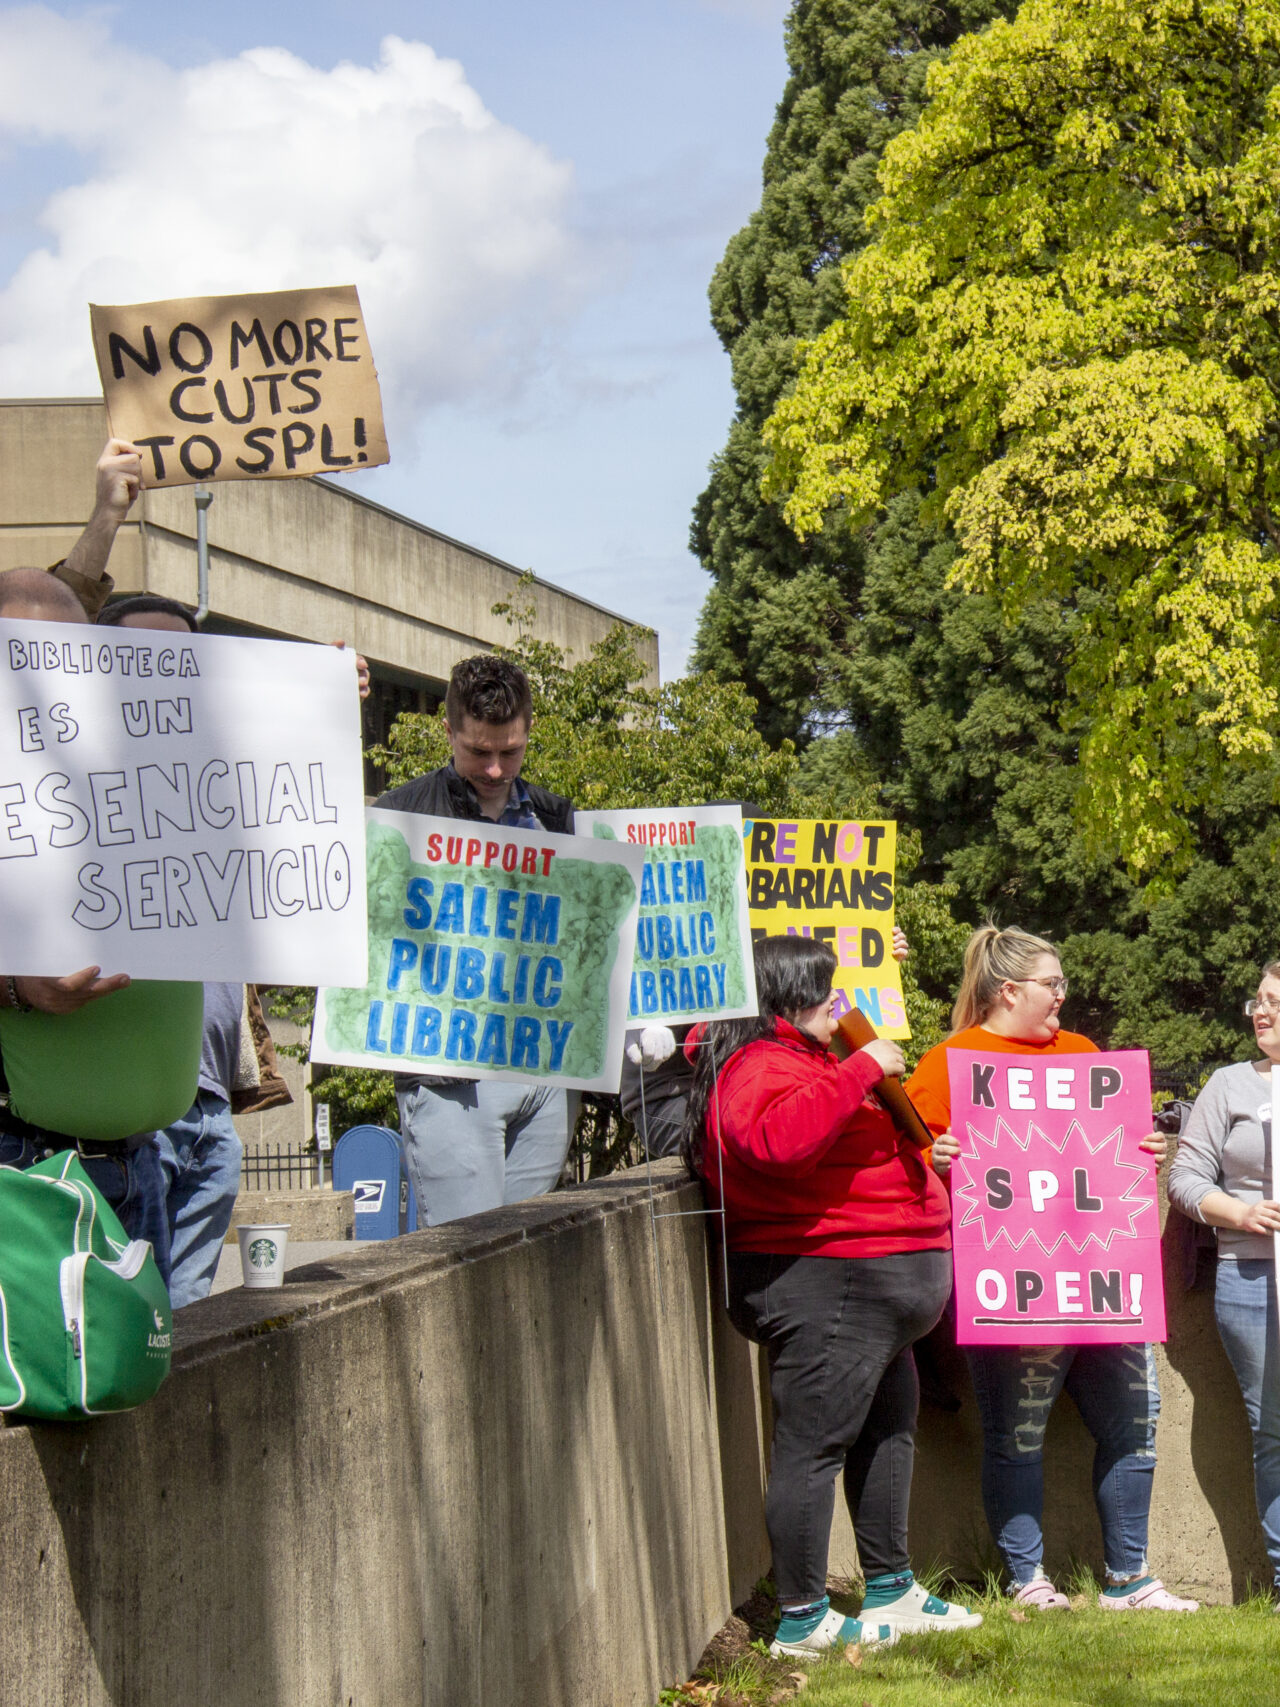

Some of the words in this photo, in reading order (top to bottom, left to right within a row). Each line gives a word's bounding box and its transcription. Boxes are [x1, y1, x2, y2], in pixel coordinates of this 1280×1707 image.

[109, 322, 213, 380] NO
[230, 317, 361, 370] MORE
[169, 368, 322, 425] CUTS
[133, 434, 222, 480] TO
[235, 417, 369, 474] SPL!
[8, 639, 200, 678] BIBLIOTECA
[18, 702, 79, 752] ES
[122, 697, 193, 737] UN
[0, 759, 338, 859] ESENCIAL
[627, 820, 697, 847] SUPPORT
[427, 833, 556, 877] SUPPORT
[812, 822, 885, 865] NOT
[71, 841, 351, 930] SERVICIO
[640, 859, 707, 906] ALEM
[745, 868, 893, 911] BARIANS
[403, 877, 561, 946] SALEM
[637, 911, 716, 961] UBLIC
[387, 938, 563, 1009] PUBLIC
[629, 963, 726, 1016] IBRARY
[365, 1000, 574, 1071] LIBRARY
[971, 1063, 1122, 1110] KEEP
[985, 1167, 1102, 1212] SPL
[976, 1268, 1143, 1316] OPEN!
